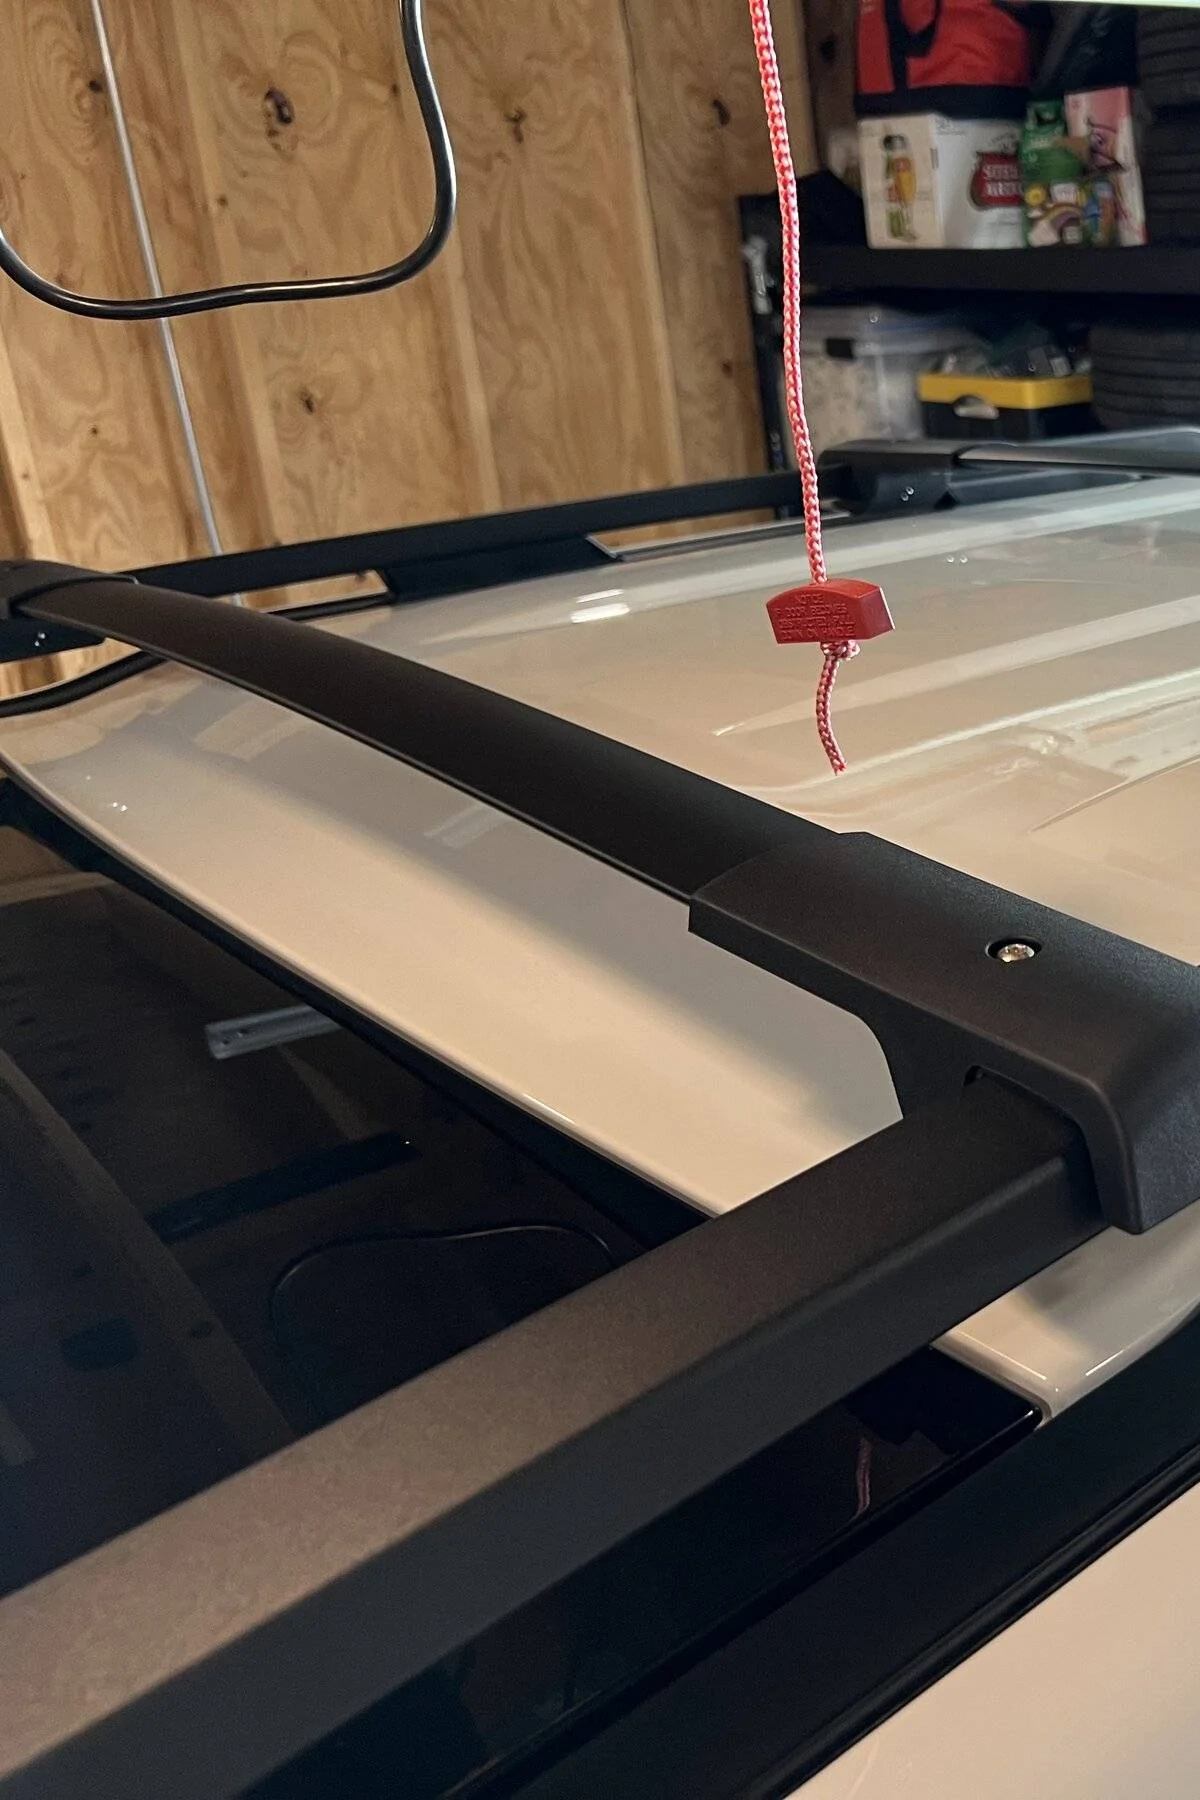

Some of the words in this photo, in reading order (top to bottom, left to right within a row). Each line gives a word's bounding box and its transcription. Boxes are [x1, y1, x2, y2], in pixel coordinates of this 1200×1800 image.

[794, 593, 824, 605] NOTICE
[785, 606, 806, 617] DOOR
[809, 603, 848, 616] BECOMES
[822, 624, 857, 638] HANDLE
